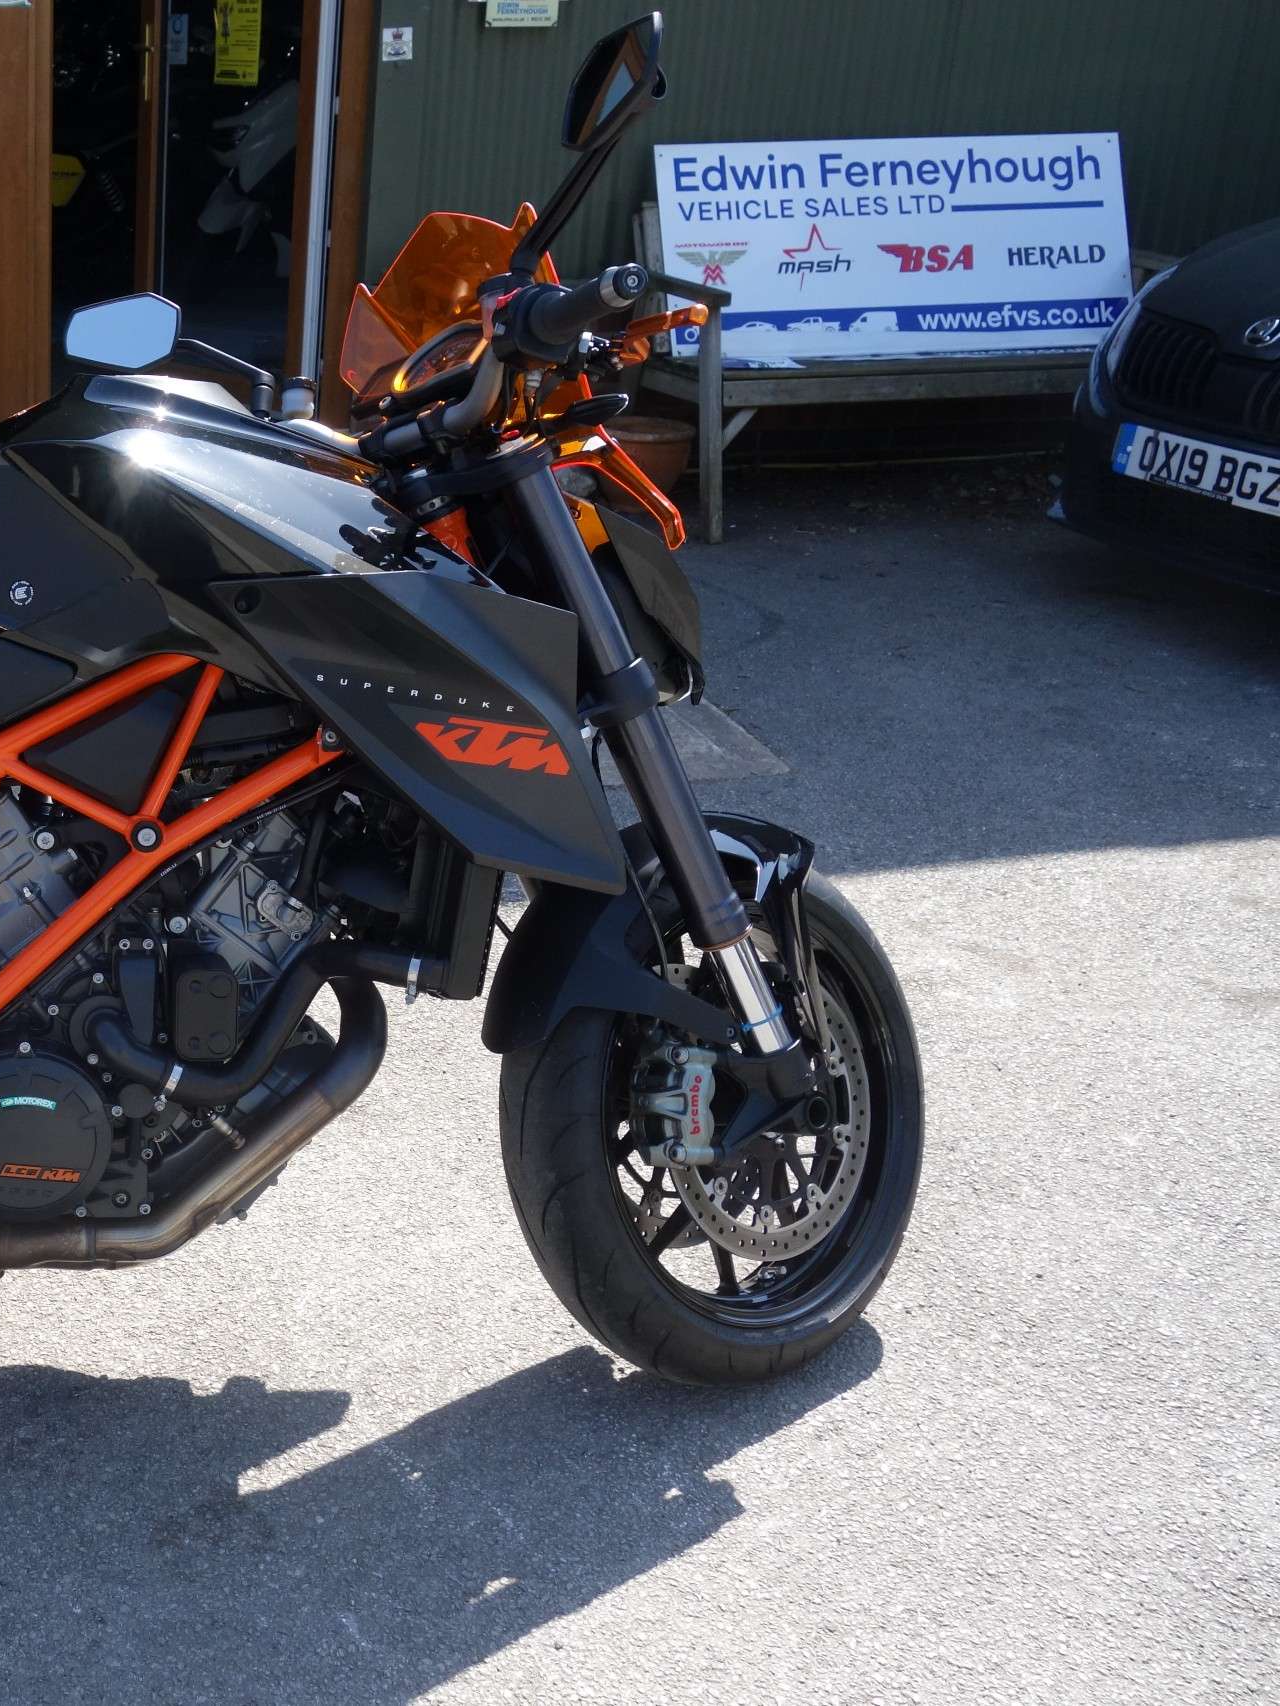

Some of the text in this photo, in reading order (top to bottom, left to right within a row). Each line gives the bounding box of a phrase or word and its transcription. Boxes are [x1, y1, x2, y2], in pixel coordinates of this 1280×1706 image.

[672, 145, 1101, 194] Edwin Ferneyhough
[678, 194, 946, 222] VEHICLE SALES LTD
[896, 244, 974, 273] BSA
[1007, 244, 1106, 269] HERALD
[917, 301, 1115, 330] www.efvs.co.uk
[1139, 436, 1209, 486] OX19
[1212, 455, 1280, 508] BGZ
[415, 716, 570, 776] KTM
[14, 1097, 55, 1109] MOTOREX
[689, 1075, 703, 1136] brembo
[41, 1168, 81, 1183] KTM
